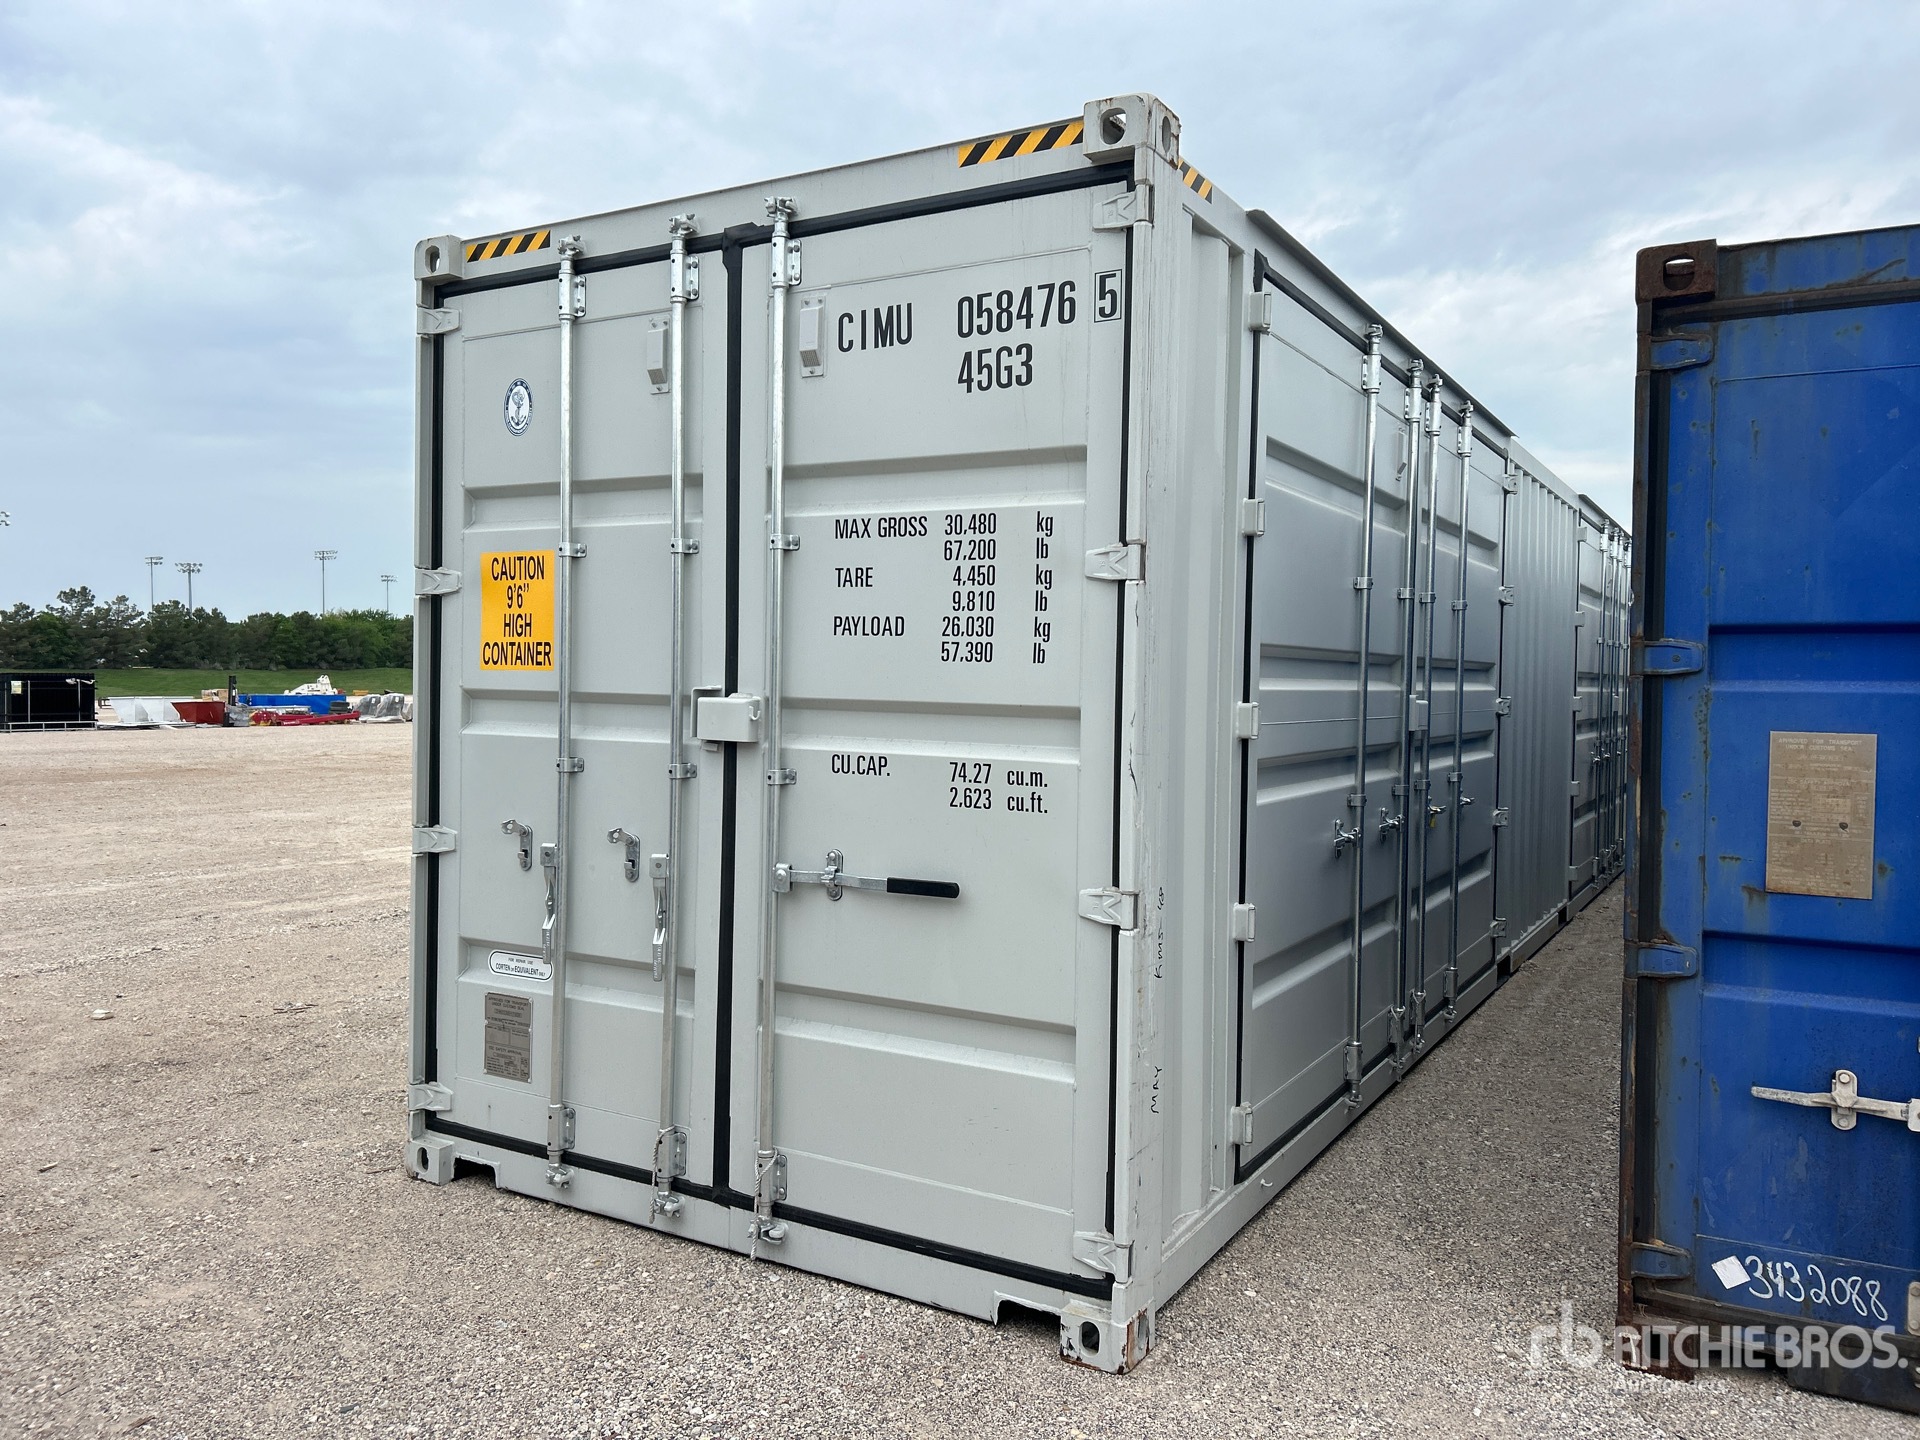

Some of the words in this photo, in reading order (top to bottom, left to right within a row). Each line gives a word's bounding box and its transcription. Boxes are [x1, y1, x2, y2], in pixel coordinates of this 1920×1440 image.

[837, 303, 913, 353] CIMU
[957, 280, 1077, 338] 058476
[1098, 273, 1117, 318] 5
[957, 343, 1033, 394] 45G3
[834, 518, 871, 539] MAX
[878, 516, 928, 538] GROSS
[944, 512, 997, 536] 30,480
[1036, 511, 1054, 537] kg
[943, 538, 996, 561] 67,200
[1035, 538, 1049, 559] lb
[491, 555, 545, 581] CAUTION
[835, 567, 874, 587] TARE
[952, 564, 996, 587] 4,450
[1035, 564, 1053, 590] kg
[952, 590, 995, 612] 9,810
[1034, 590, 1048, 611] lb
[503, 613, 532, 638] HIGH
[833, 616, 905, 637] PAYLOAD
[941, 616, 994, 638] 26,030
[1033, 617, 1051, 642] kg
[482, 641, 552, 666] CONTAINER
[941, 641, 993, 663] 57,390
[1032, 643, 1046, 664] lb
[831, 753, 891, 776] CU.CAP.
[949, 762, 992, 784] 74.27
[1007, 769, 1048, 788] cu.m.
[949, 787, 992, 810] 2,623
[1007, 792, 1048, 813] cu.ft.
[515, 966, 539, 976] EQUIVALENT
[1744, 1255, 1889, 1321] 3432088
